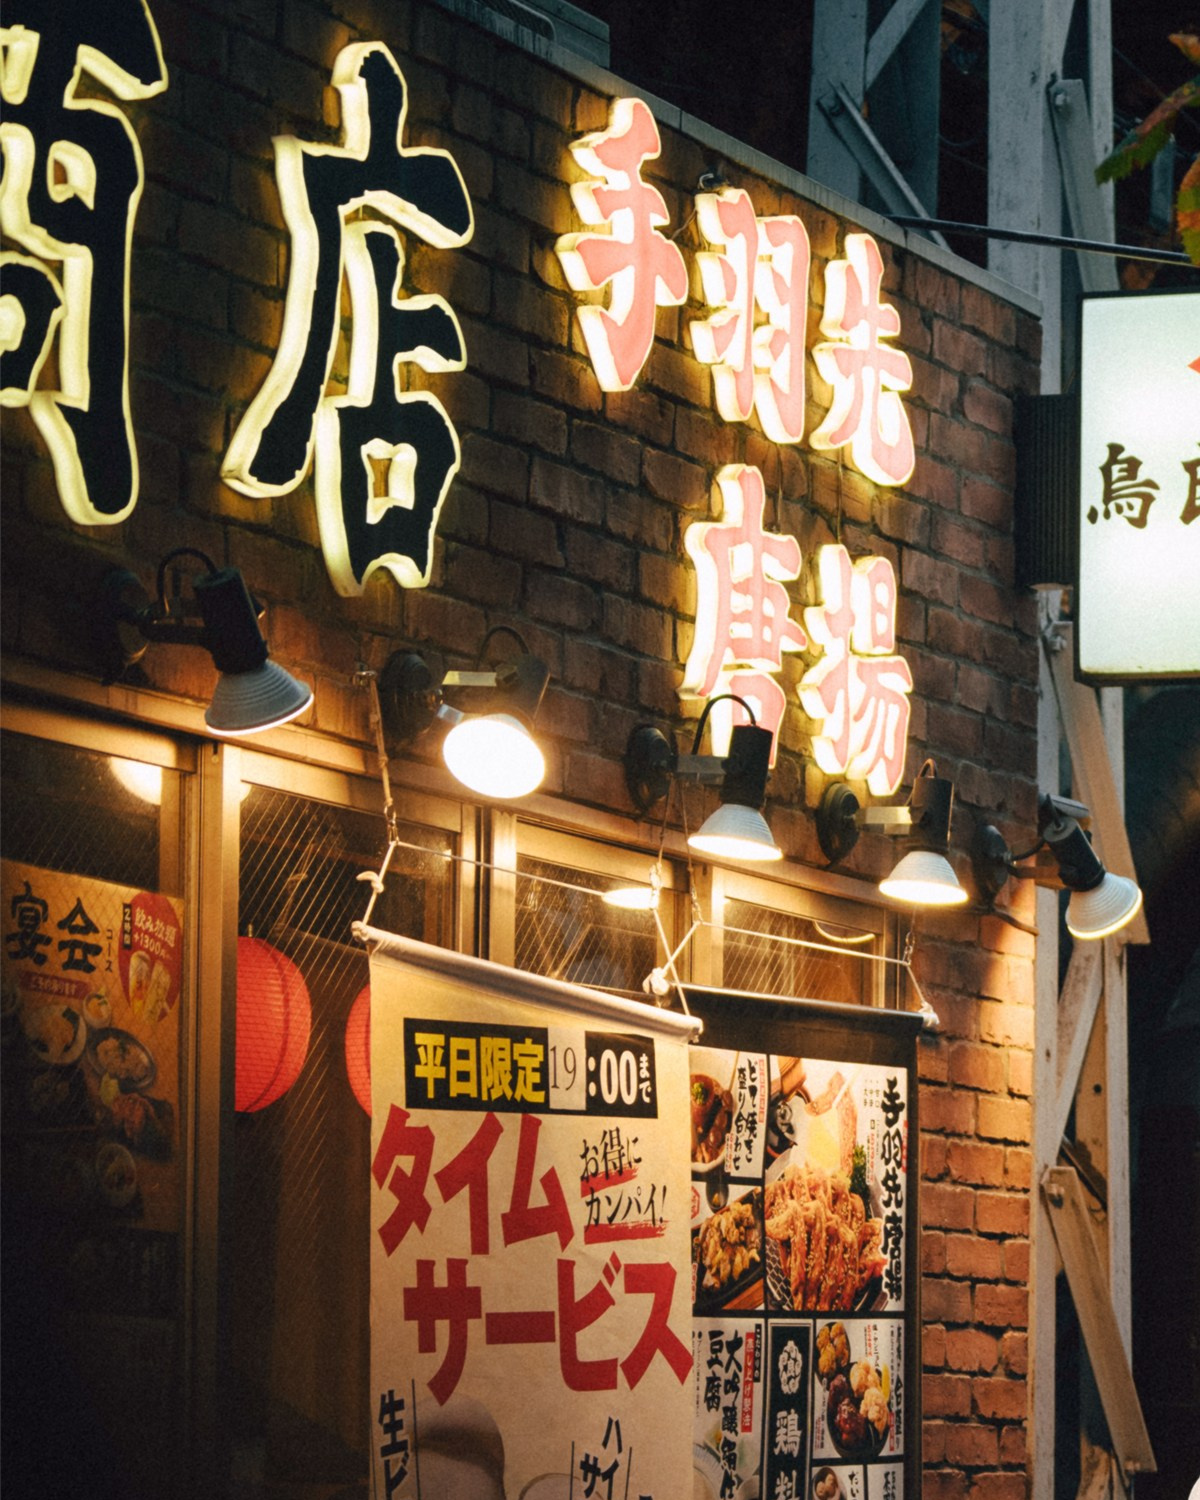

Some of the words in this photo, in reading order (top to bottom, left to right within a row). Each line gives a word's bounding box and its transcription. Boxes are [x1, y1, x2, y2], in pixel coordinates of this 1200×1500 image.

[556, 97, 915, 487] 手羽先
[679, 463, 912, 796] 唐揚
[7, 879, 102, 974] 宴会
[105, 928, 113, 973] コース
[414, 1032, 546, 1104] 平日限定
[371, 1103, 575, 1258] タイム
[580, 1126, 642, 1182] お得に
[403, 1251, 694, 1407] サービス
[704, 1330, 725, 1413] 豆腐
